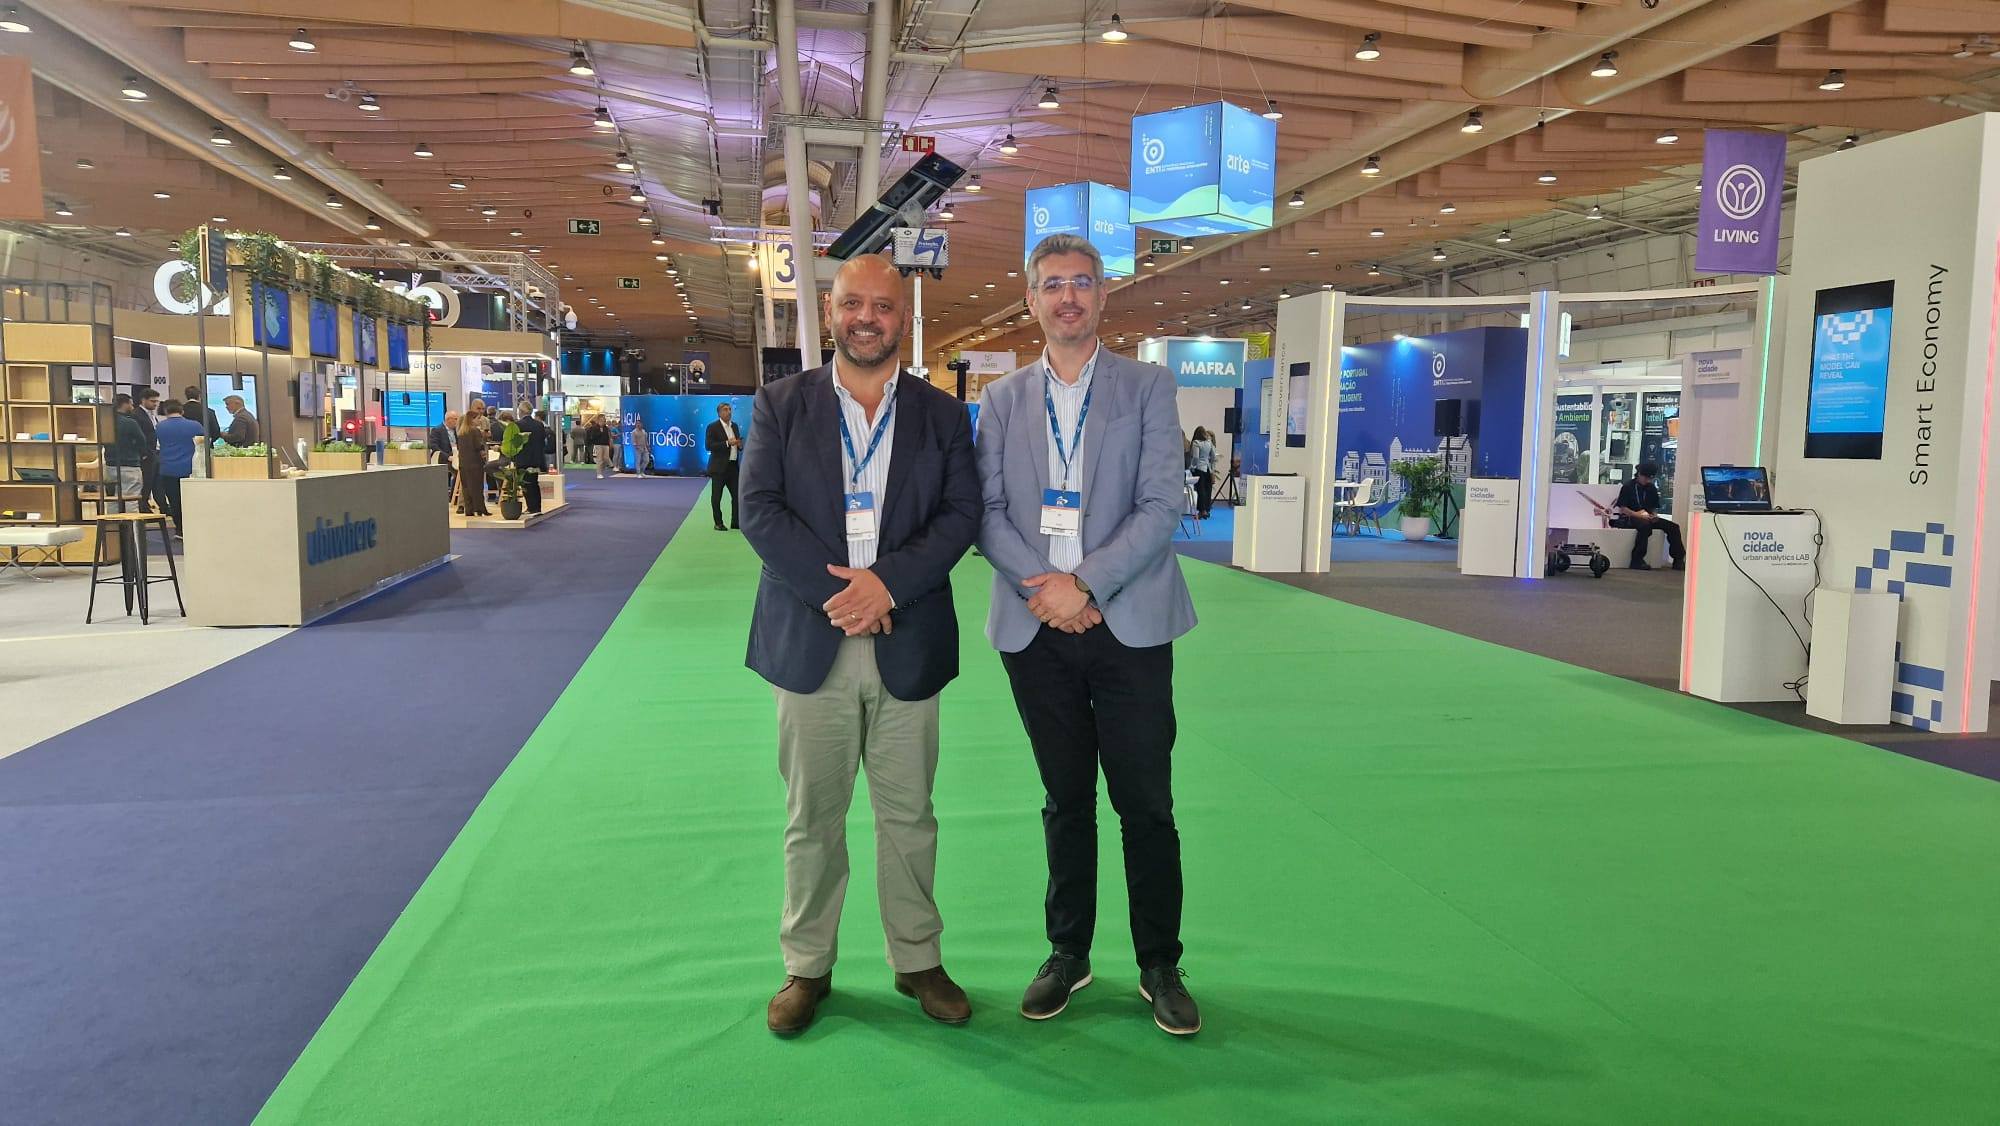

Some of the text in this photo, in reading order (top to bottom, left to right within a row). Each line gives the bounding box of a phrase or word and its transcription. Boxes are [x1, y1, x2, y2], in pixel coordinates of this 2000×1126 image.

[1226, 154, 1250, 175] arte
[1094, 220, 1114, 235] arte
[1714, 229, 1759, 244] LIVING
[1181, 360, 1236, 375] MAFRA
[1909, 264, 1949, 485] Smart Economy
[1559, 412, 1590, 422] Ambiente
[1646, 413, 1664, 422] Inteli
[307, 512, 377, 566] ubiwhere
[1743, 531, 1774, 540] nova
[1742, 540, 1785, 553] cidade
[1742, 553, 1810, 562] urban analytics LAB
